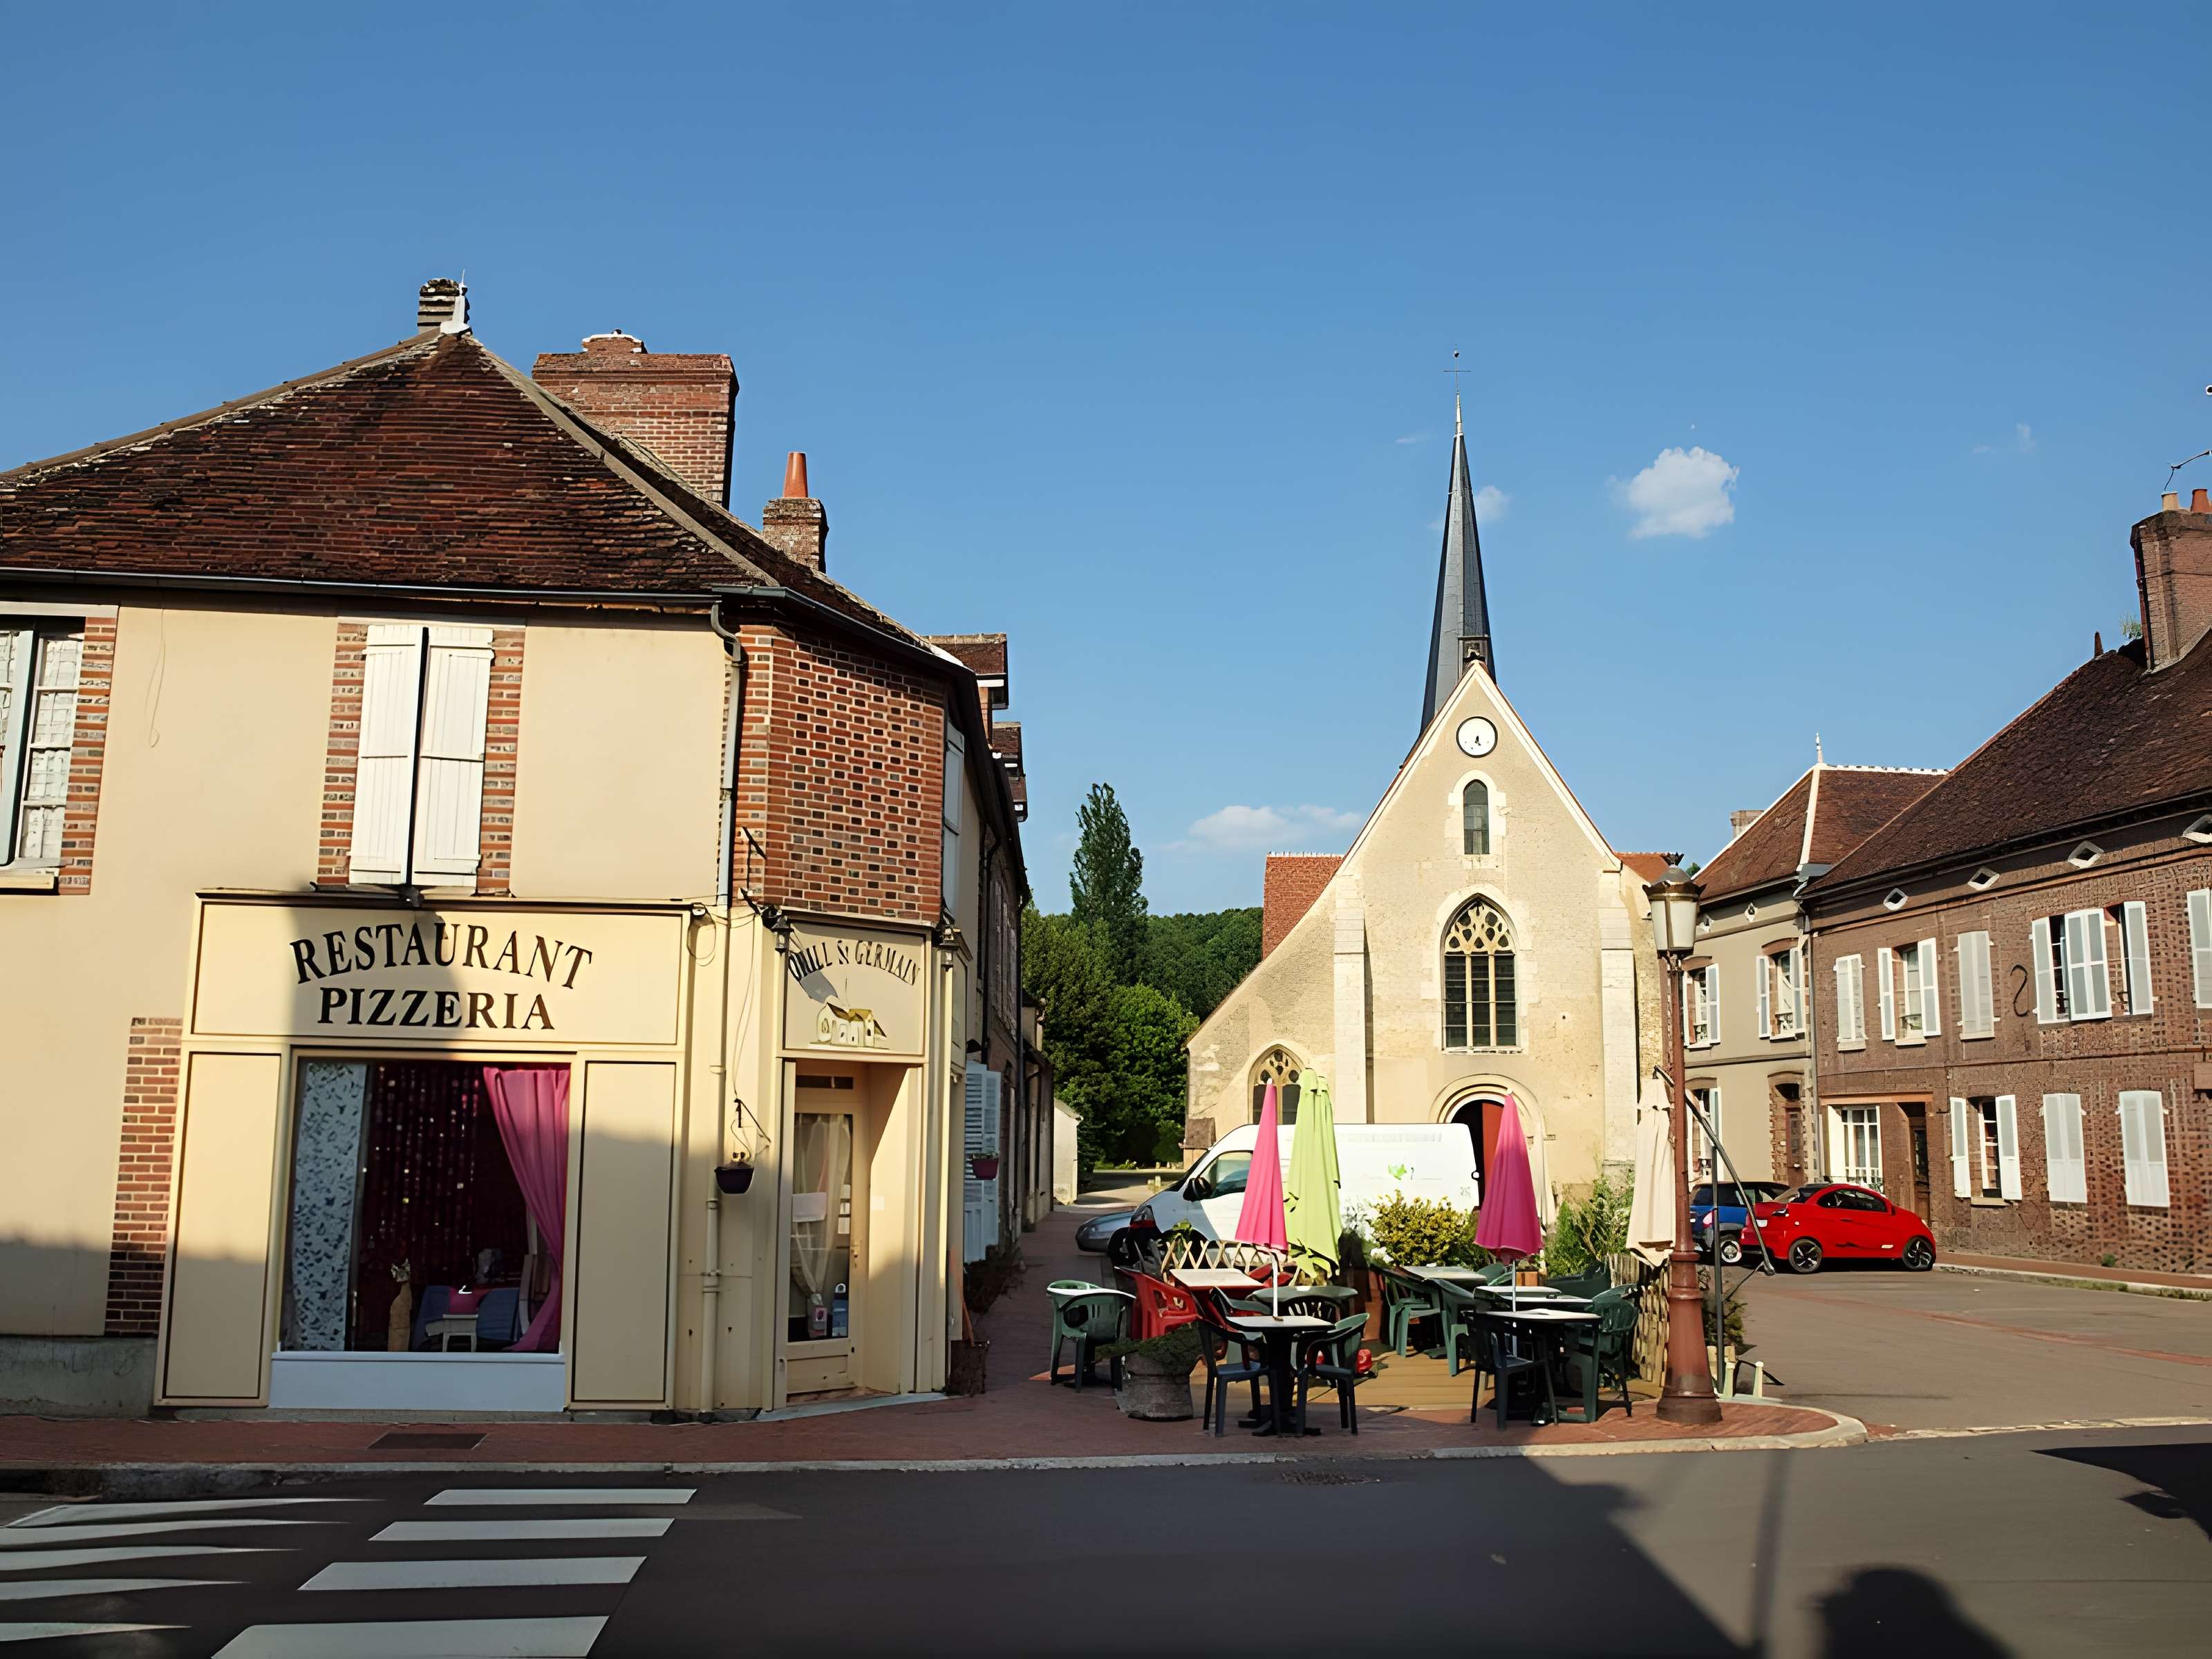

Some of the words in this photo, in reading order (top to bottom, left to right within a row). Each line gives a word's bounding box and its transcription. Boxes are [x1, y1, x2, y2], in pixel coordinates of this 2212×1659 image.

[290, 922, 592, 989] RESTAURANT
[855, 940, 920, 986] GERMAIN
[317, 987, 555, 1030] PIZZERIA
